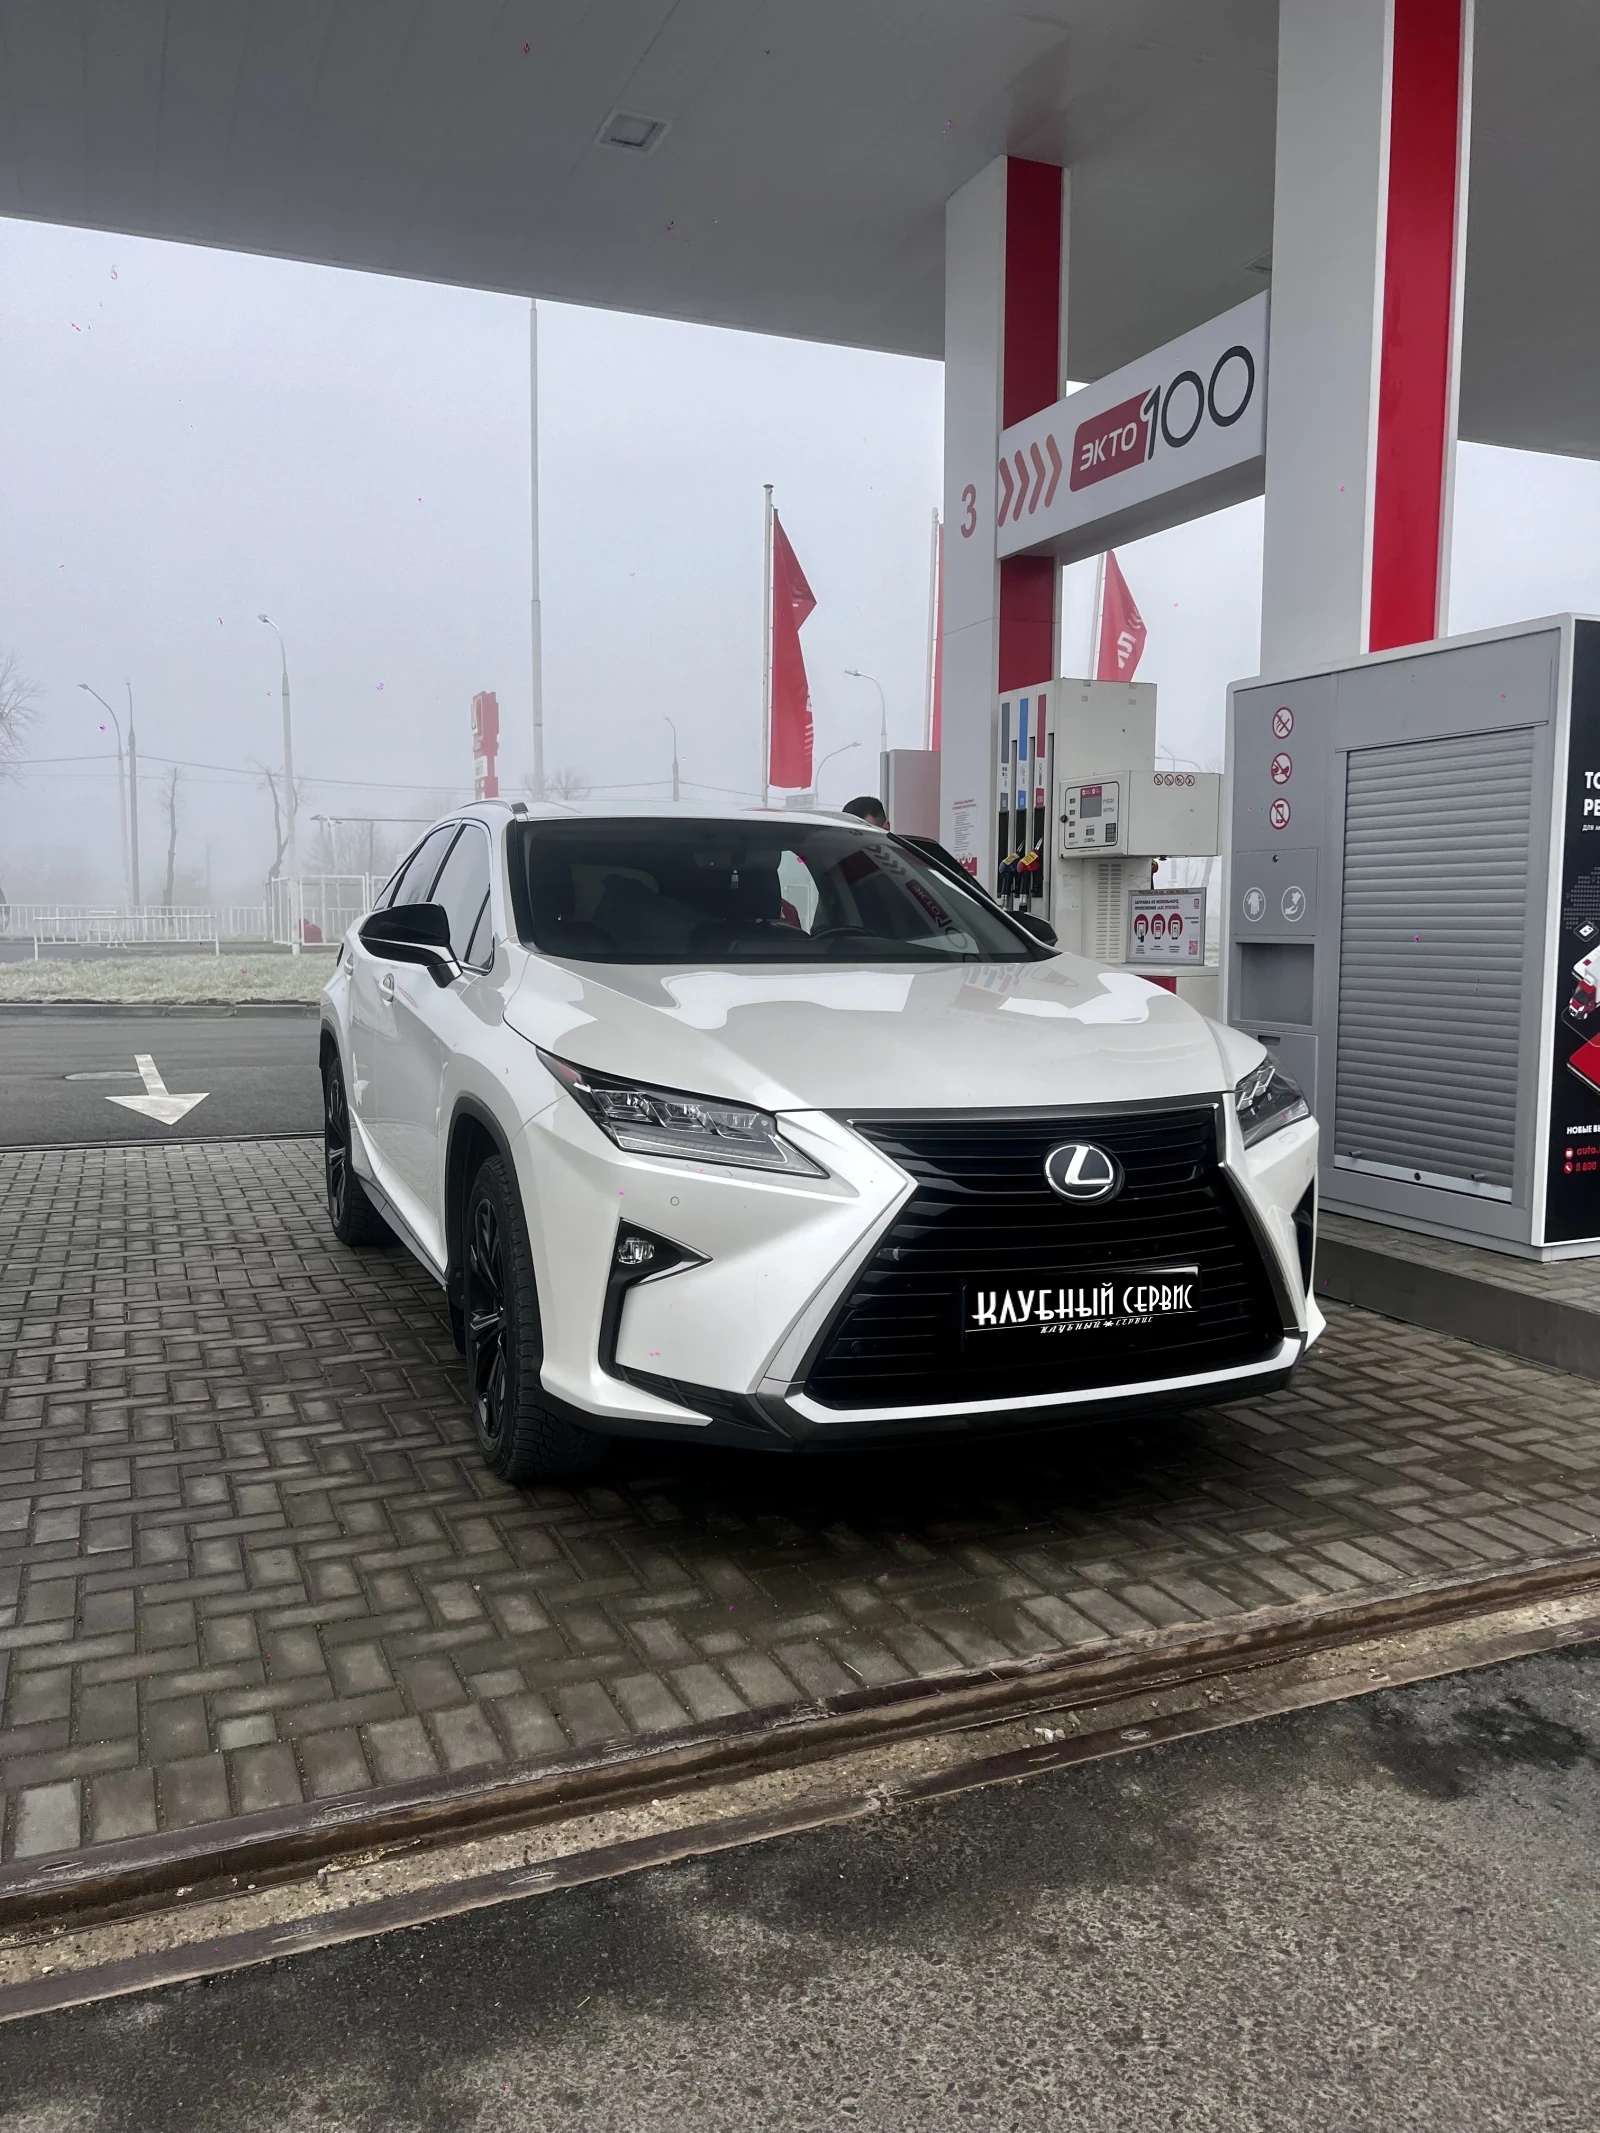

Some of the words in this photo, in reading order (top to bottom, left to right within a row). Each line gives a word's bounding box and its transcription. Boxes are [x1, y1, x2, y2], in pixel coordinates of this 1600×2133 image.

[1080, 422, 1137, 471] ЭКТО
[1144, 345, 1255, 460] 100
[960, 483, 977, 538] 3
[972, 1283, 1114, 1326] КЛУБНЫЙ
[1122, 1284, 1194, 1314] СЕРВИС
